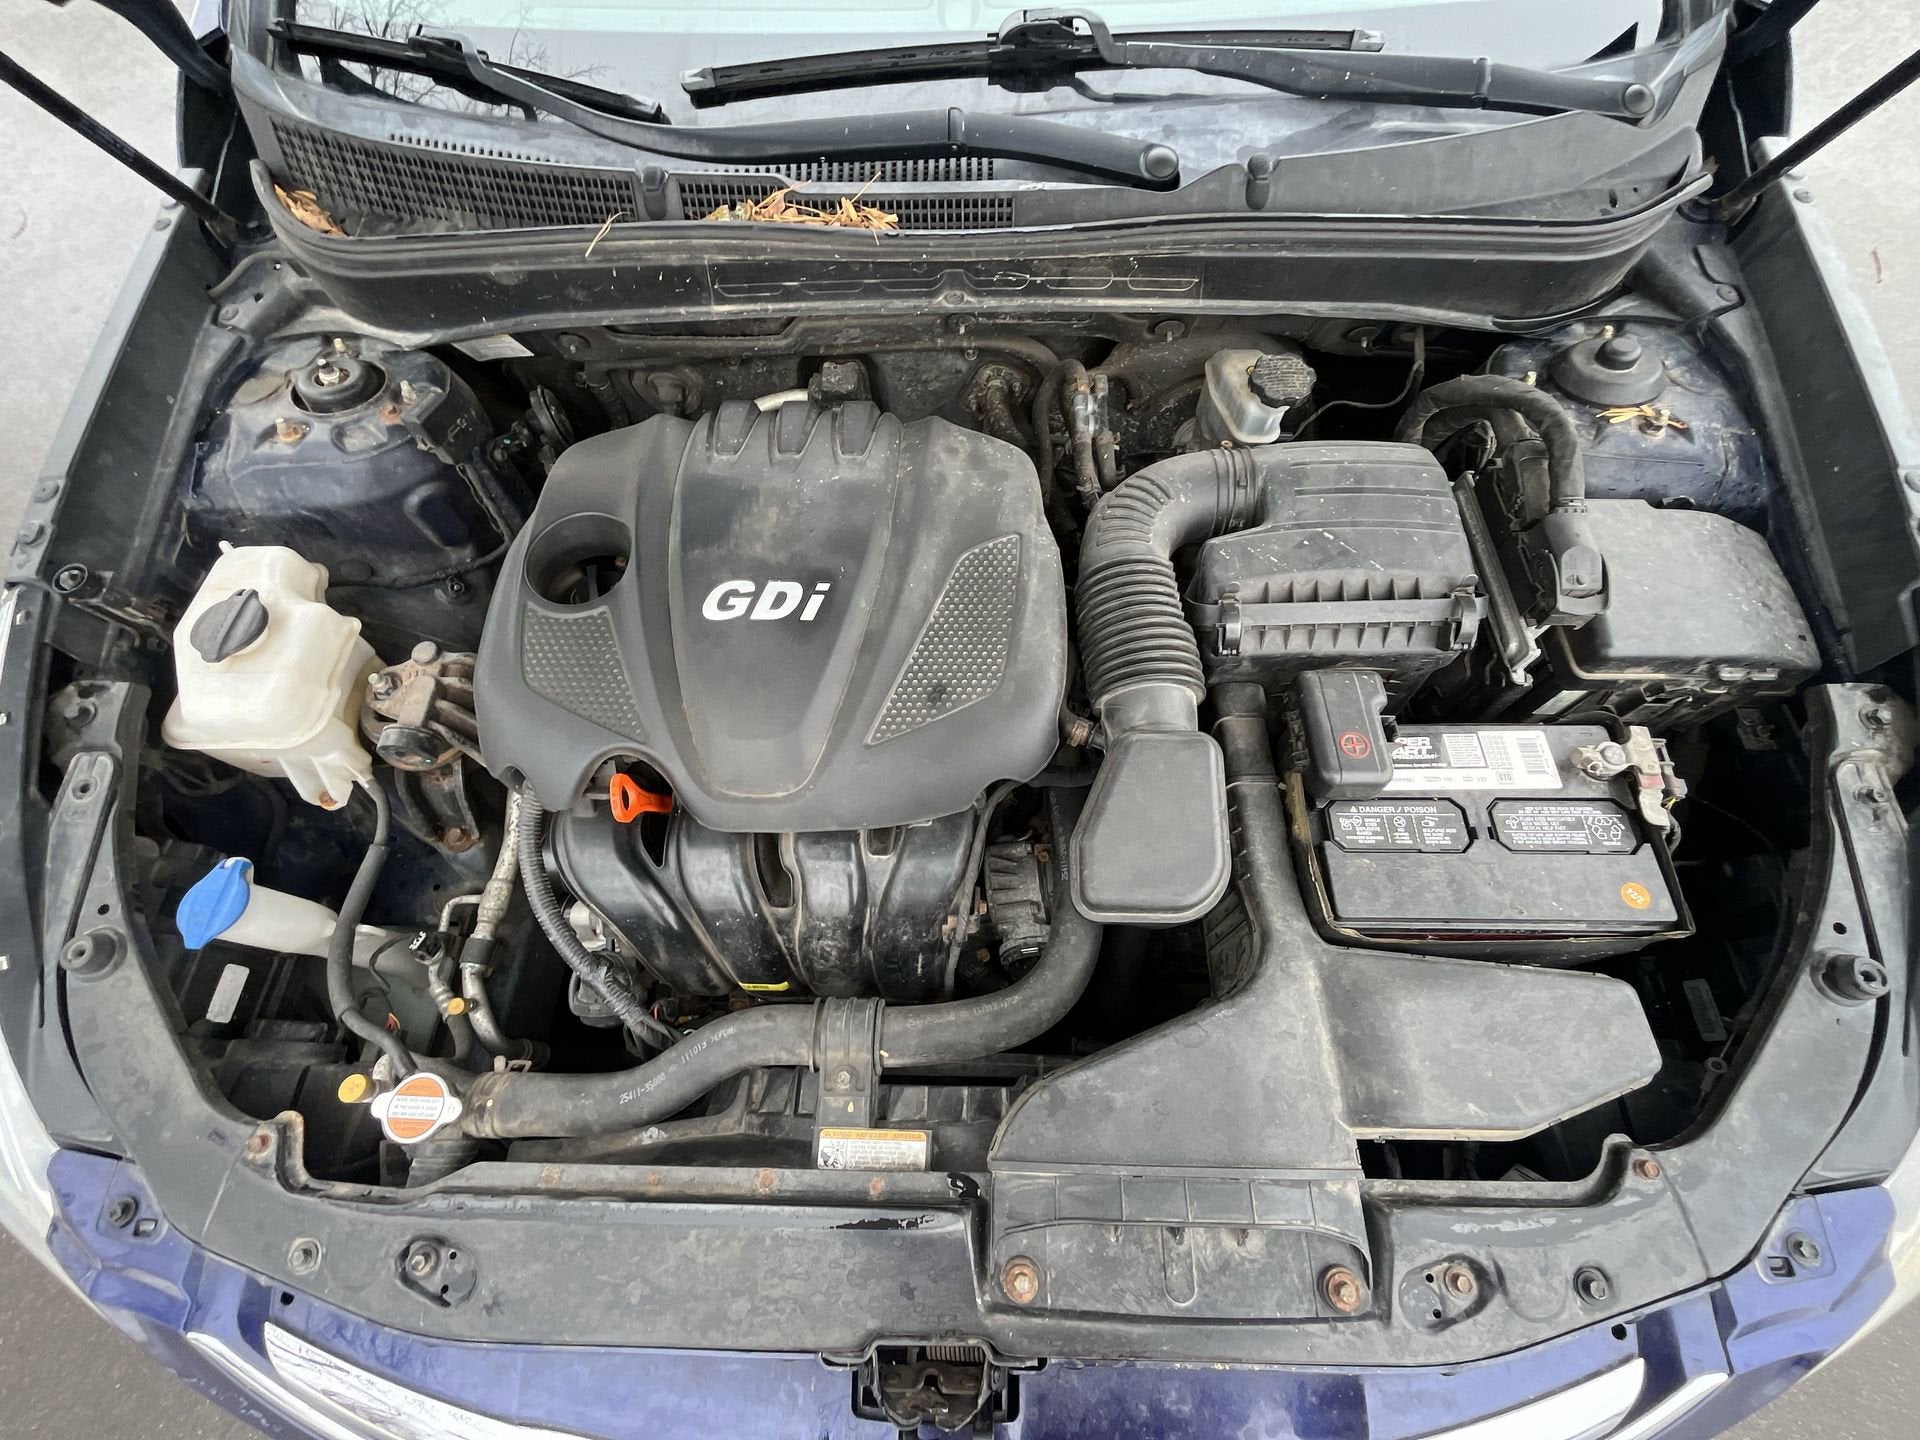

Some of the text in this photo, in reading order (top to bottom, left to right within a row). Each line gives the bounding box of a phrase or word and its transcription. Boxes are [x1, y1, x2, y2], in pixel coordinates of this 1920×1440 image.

[702, 580, 831, 621] GDi
[1359, 806, 1395, 814] DANGER
[1404, 806, 1437, 814] POISON
